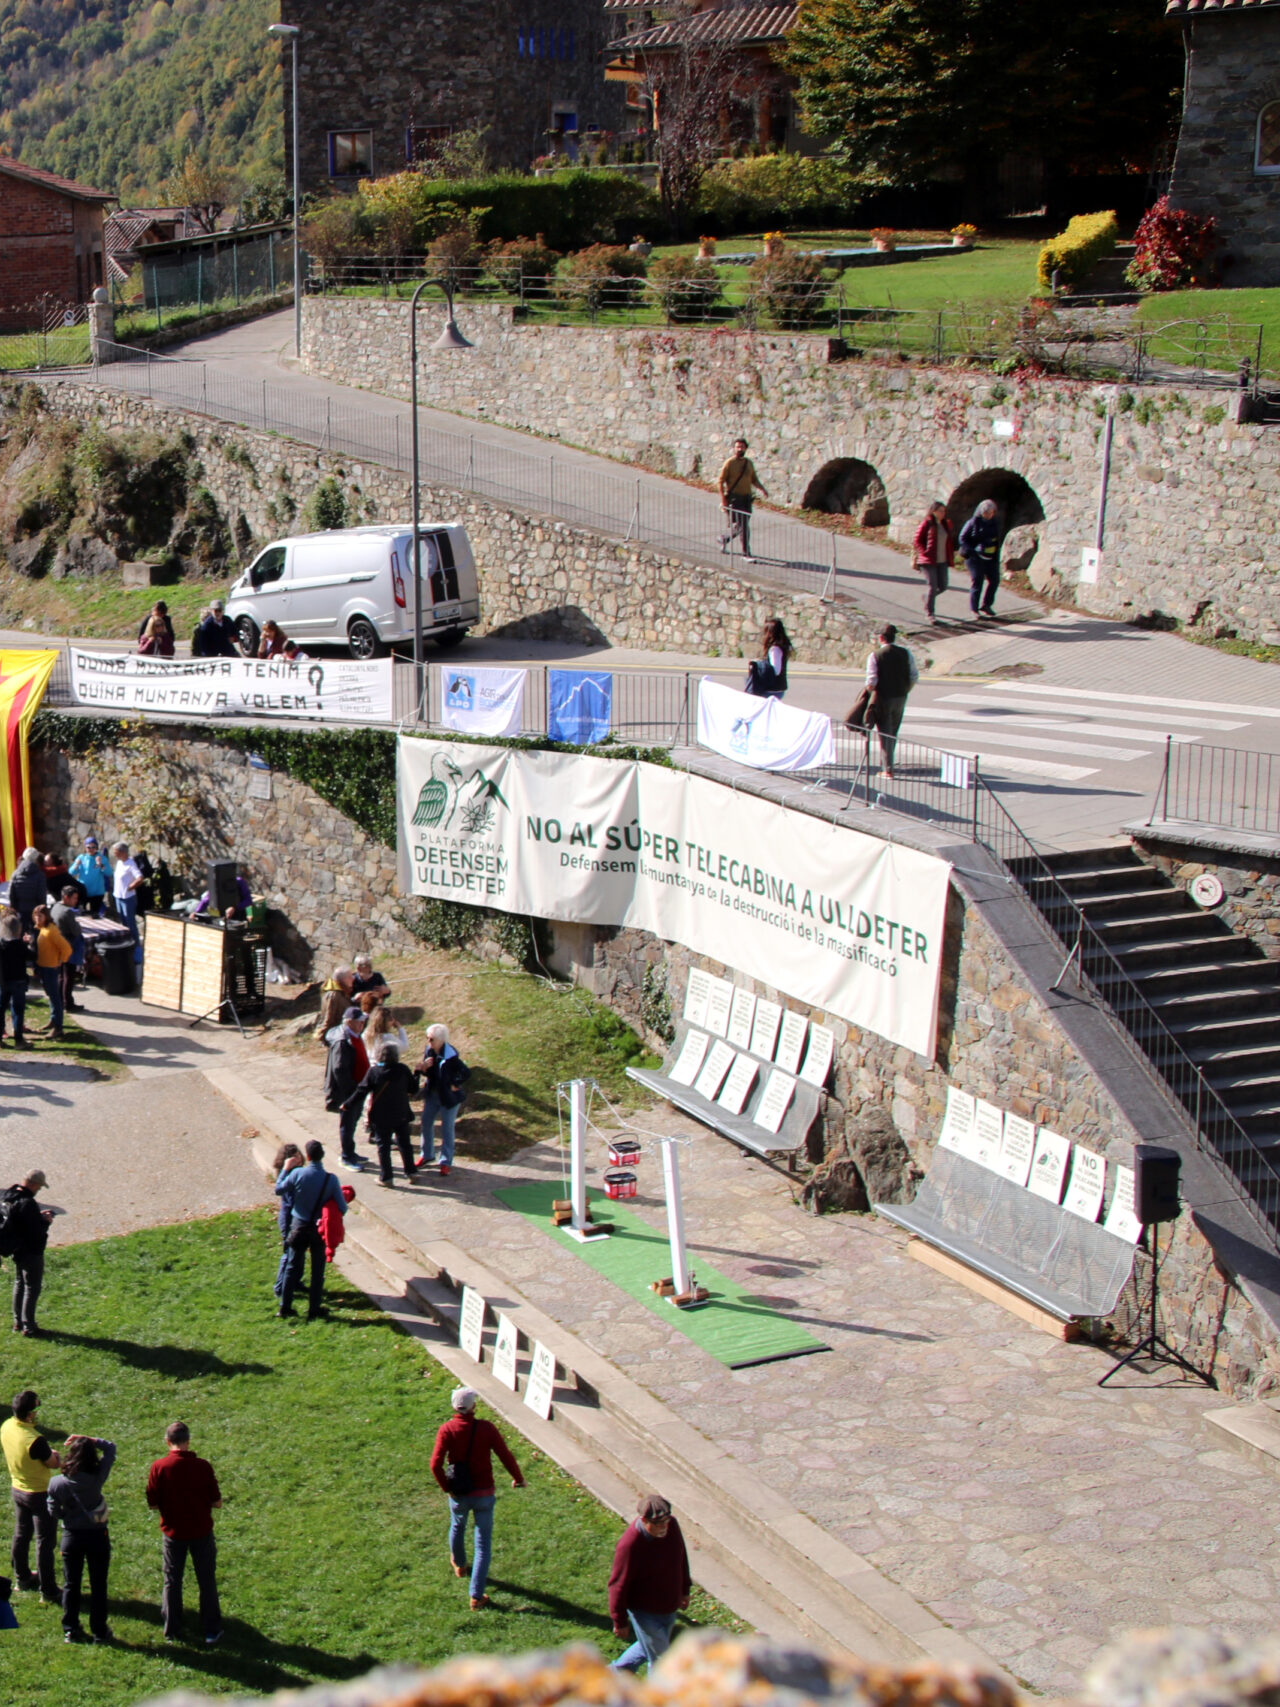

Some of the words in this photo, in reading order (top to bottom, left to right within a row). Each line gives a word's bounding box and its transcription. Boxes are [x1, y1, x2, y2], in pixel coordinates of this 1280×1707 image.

[77, 654, 126, 672] QUINA
[135, 661, 232, 677] MUNTANYA
[242, 662, 300, 680] TENIM
[135, 687, 228, 706] MUNTANYA
[241, 693, 307, 710] VOLEM
[449, 698, 470, 708] LPO
[420, 832, 505, 853] PLATAFORMA
[414, 845, 509, 876] DEFENSEM
[418, 866, 507, 896] ULLDETER
[527, 815, 562, 843] NO
[570, 822, 598, 849] AL
[605, 818, 680, 864] SÚPER
[685, 840, 797, 912] TELECABINA
[801, 889, 815, 918] A
[820, 895, 928, 964] ULLDETER
[560, 852, 637, 873] Defensem
[720, 889, 731, 907] la
[733, 895, 790, 931] destrucció
[797, 922, 812, 941] de
[814, 926, 825, 946] la
[827, 936, 898, 977] massificació
[1082, 1153, 1098, 1170] NO
